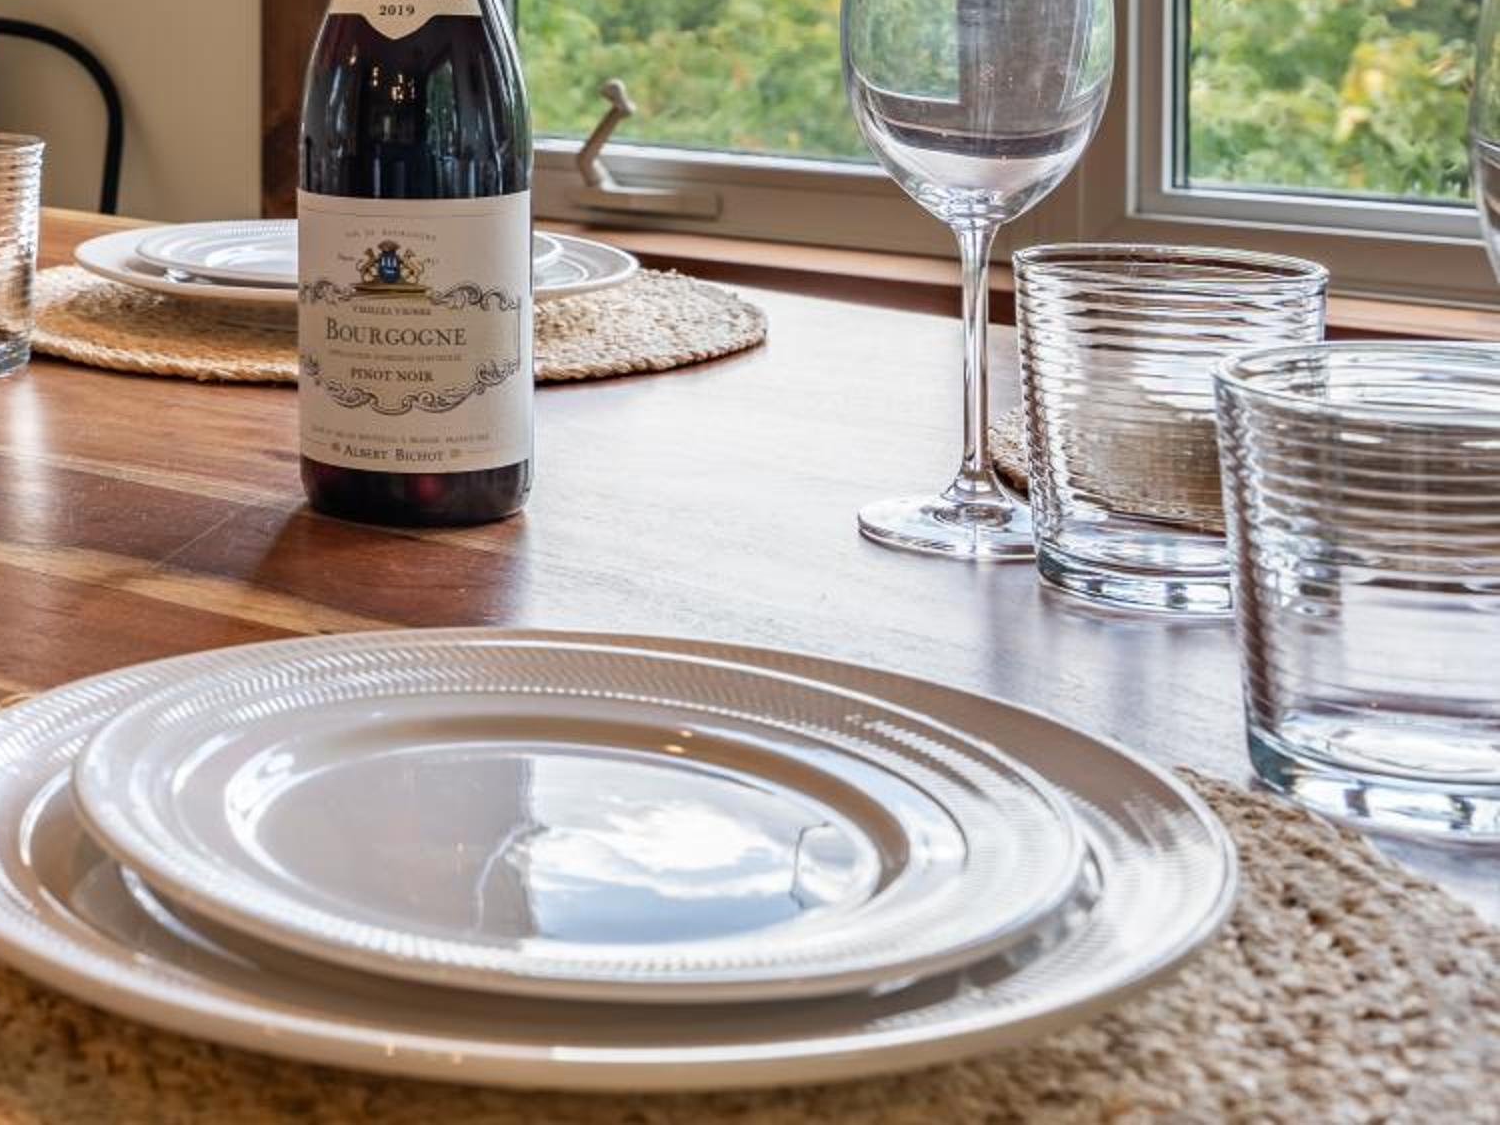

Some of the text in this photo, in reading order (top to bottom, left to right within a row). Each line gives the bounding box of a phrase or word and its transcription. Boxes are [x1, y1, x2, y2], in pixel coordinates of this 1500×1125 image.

[379, 4, 416, 16] 2019
[326, 316, 468, 347] BOURGOGNE
[350, 366, 435, 382] PINOT NOIR
[343, 444, 445, 463] ALBERT BICHOT
